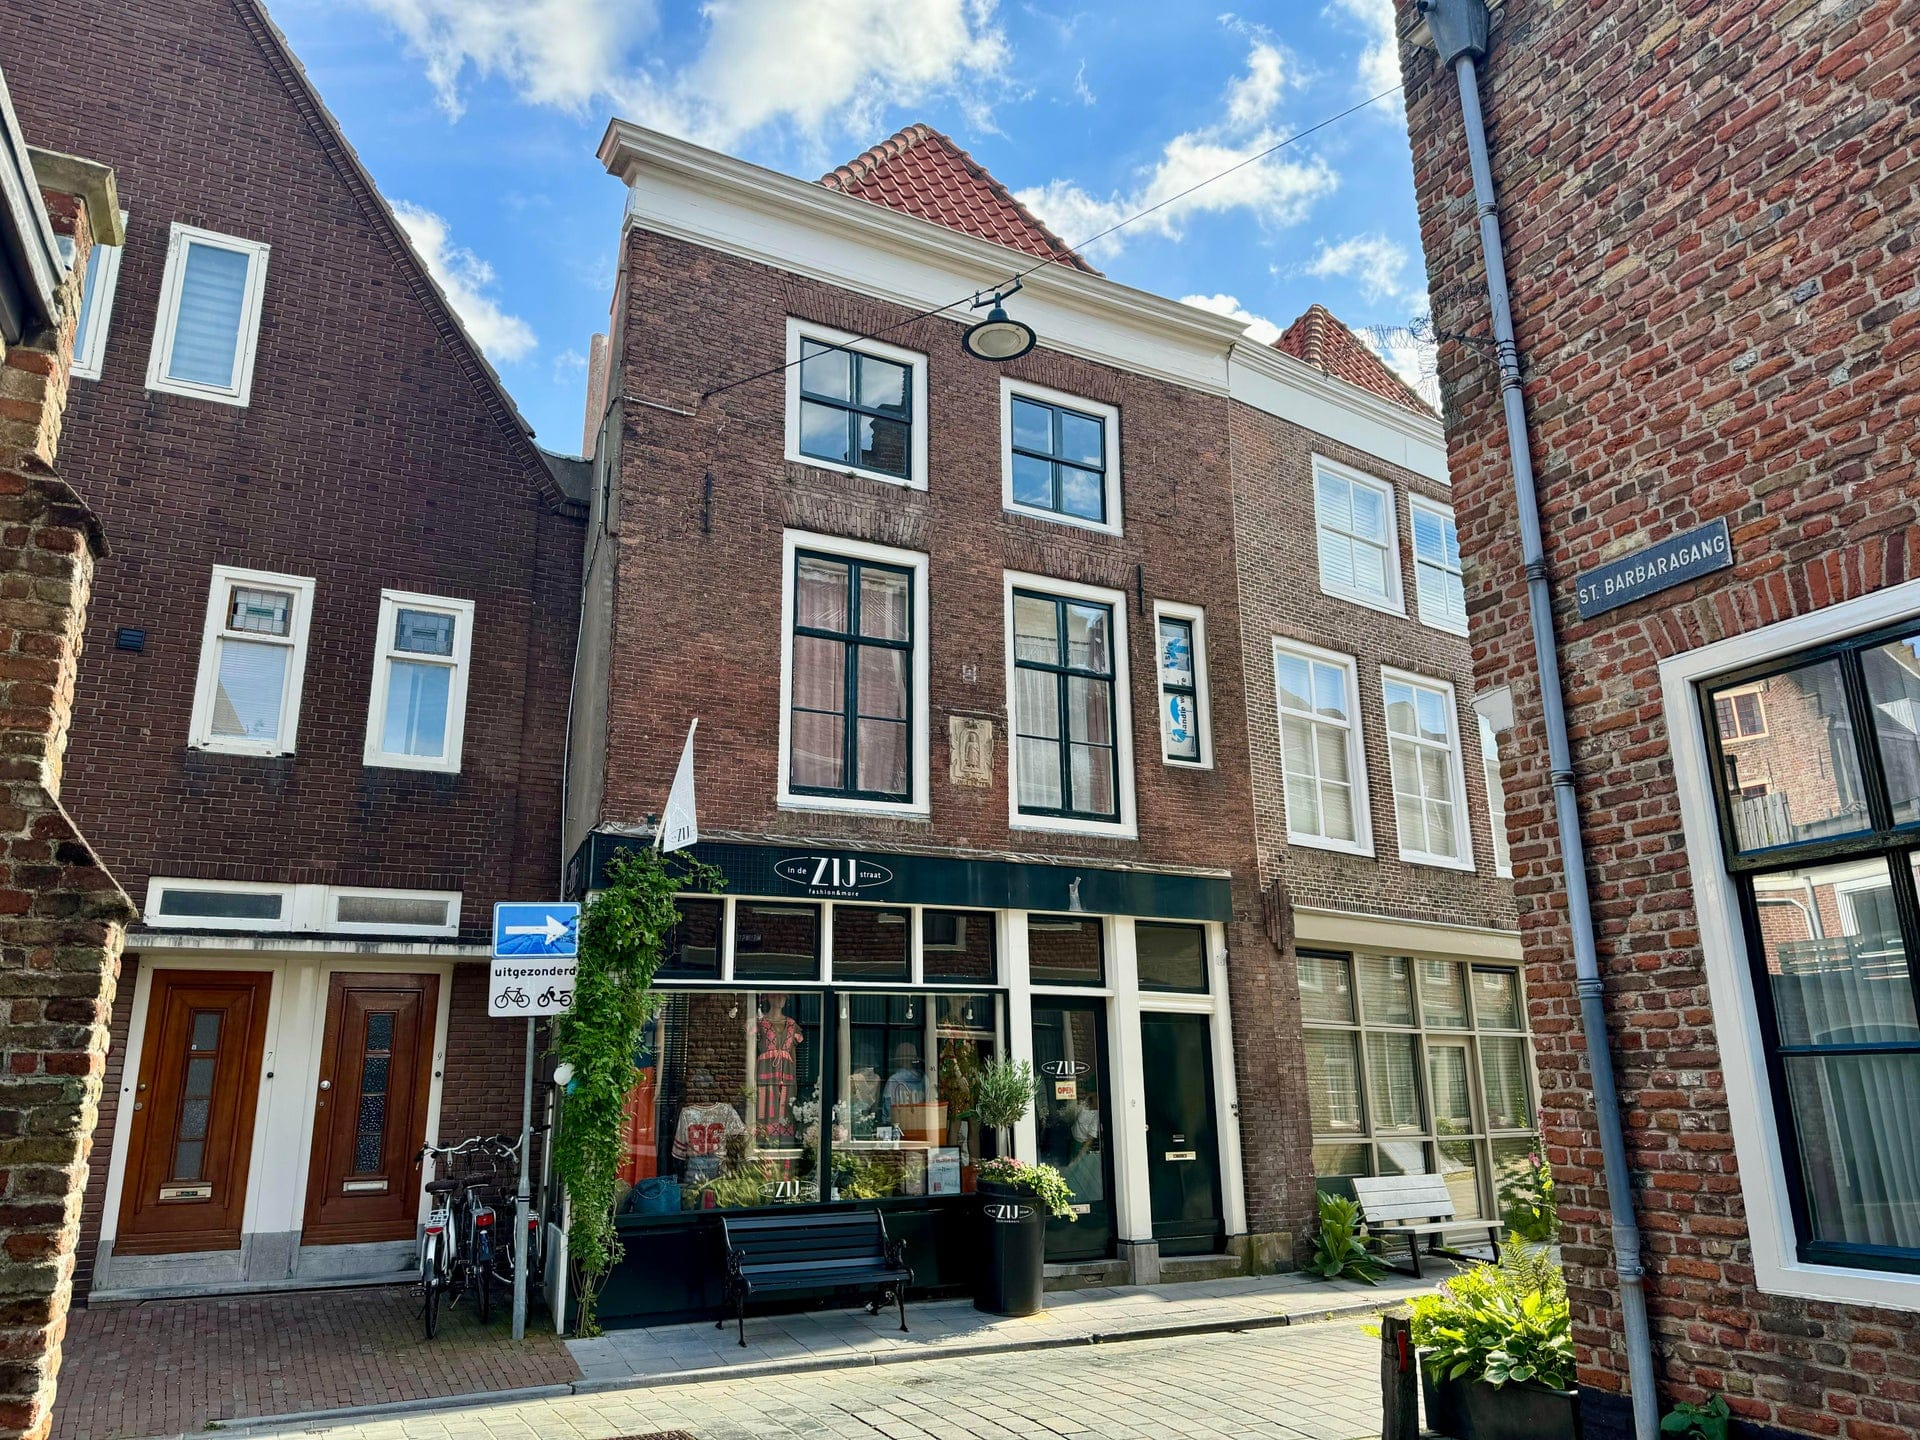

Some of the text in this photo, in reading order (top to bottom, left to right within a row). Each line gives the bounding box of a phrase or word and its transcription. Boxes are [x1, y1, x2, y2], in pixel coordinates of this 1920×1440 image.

[1579, 535, 1725, 604] ST. BARBARAGANG
[797, 867, 807, 875] de
[810, 856, 857, 888] ZIJ
[859, 871, 882, 879] straat
[494, 966, 577, 979] uitgezonderd
[1055, 1060, 1075, 1075] ZIJ
[1057, 1086, 1074, 1095] OPEN
[775, 1180, 800, 1198] ZIJ
[997, 1204, 1019, 1219] ZIJ
